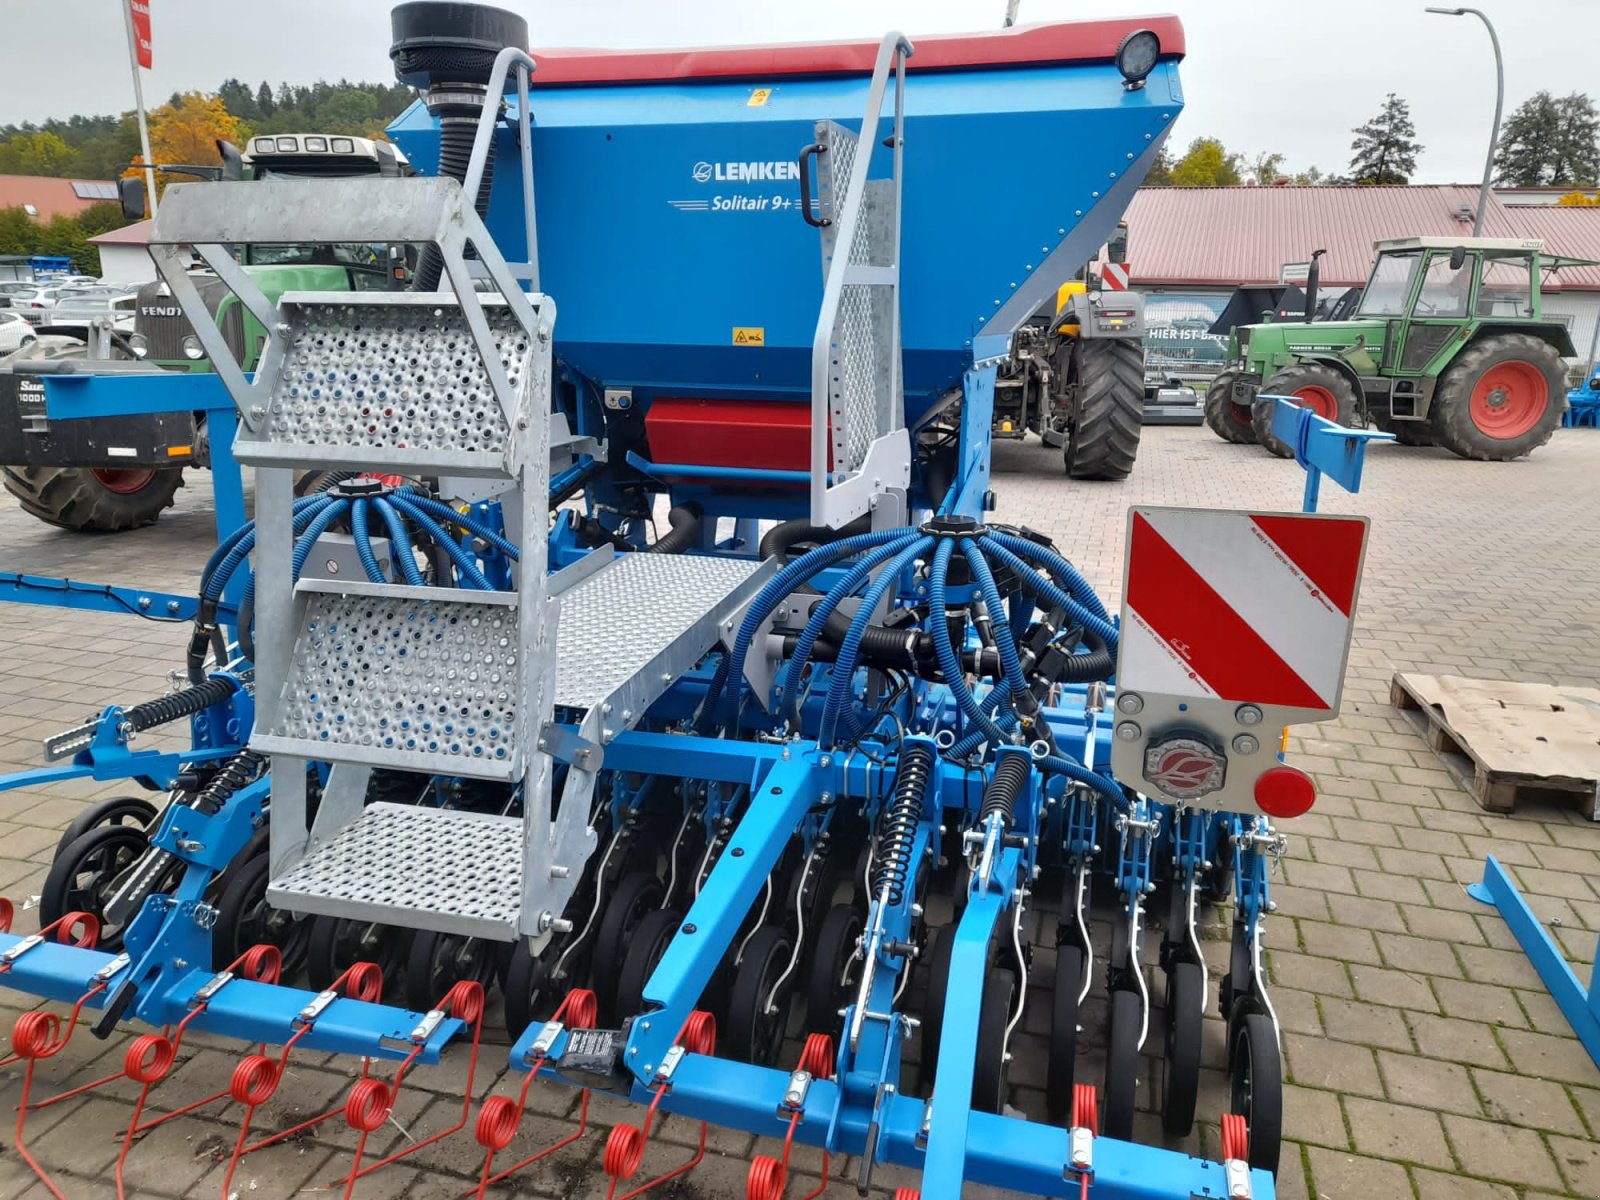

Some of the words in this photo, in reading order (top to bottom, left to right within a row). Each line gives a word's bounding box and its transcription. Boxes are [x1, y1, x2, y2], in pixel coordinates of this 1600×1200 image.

[715, 161, 801, 184] LEMKEN
[711, 195, 768, 211] Solitair
[771, 195, 792, 210] 9+
[141, 306, 182, 316] FENDT
[1149, 328, 1178, 339] HIER
[1180, 329, 1198, 340] IST
[20, 380, 45, 391] Sue
